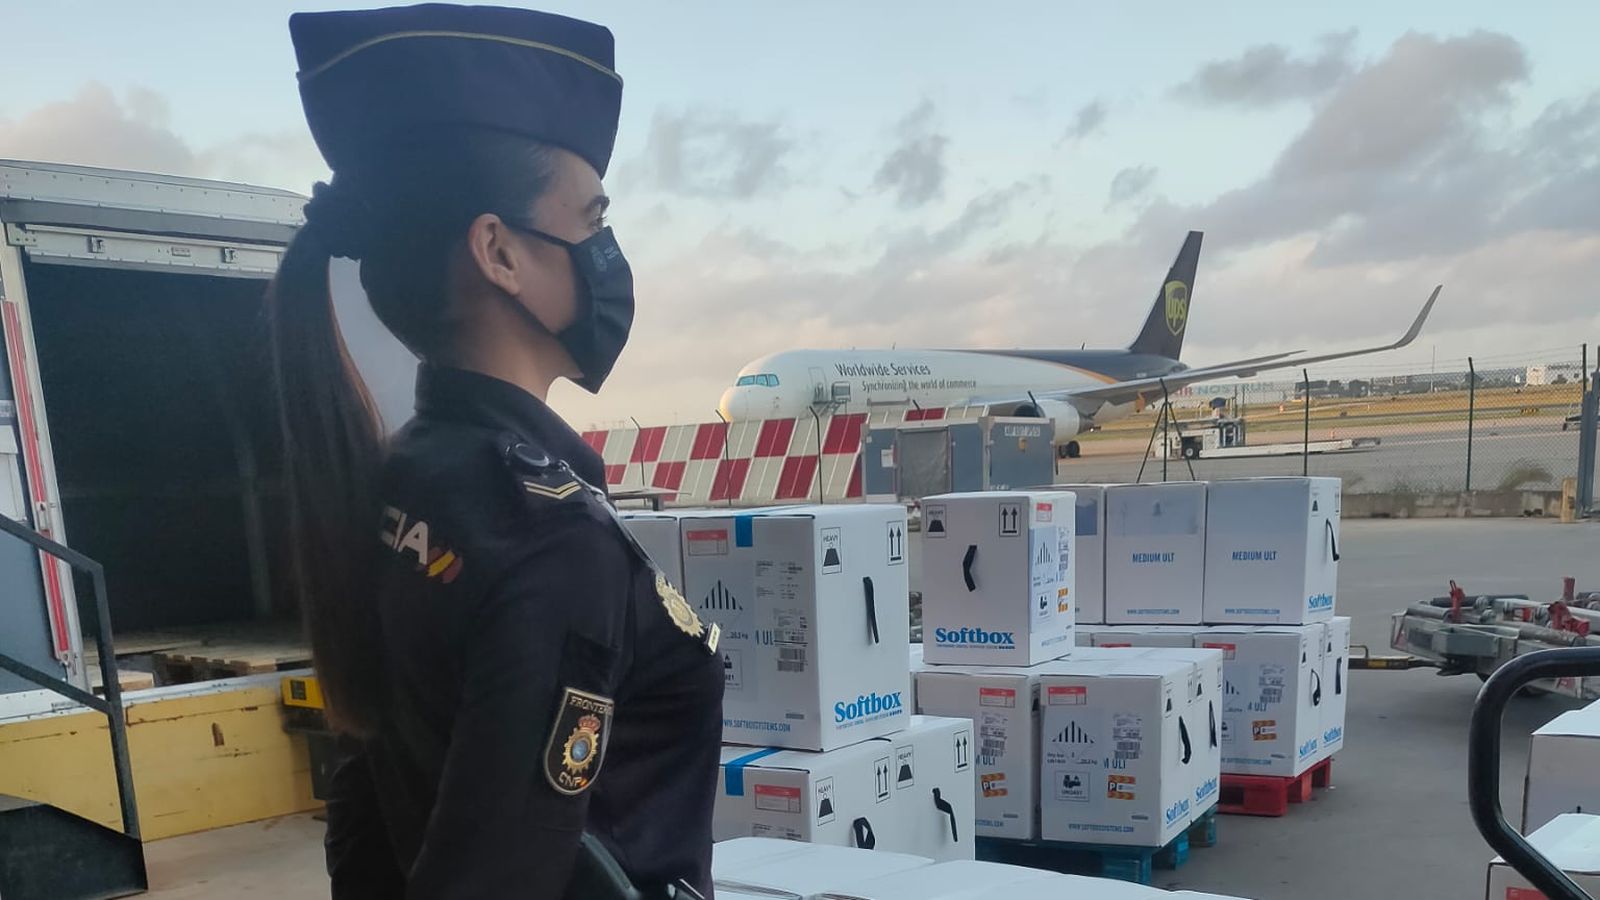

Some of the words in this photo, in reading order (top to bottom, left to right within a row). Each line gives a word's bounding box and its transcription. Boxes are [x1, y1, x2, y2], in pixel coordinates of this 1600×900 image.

[835, 363, 890, 376] Worldwide
[890, 363, 931, 376] Services
[862, 380, 907, 392] Synchronizing
[908, 380, 919, 390] the
[920, 379, 937, 390] world
[939, 379, 946, 389] of
[947, 380, 976, 389] commerce
[1132, 552, 1160, 563] MEDIUM
[1162, 552, 1175, 562] ULT
[1232, 551, 1261, 561] MEDIUM
[1263, 550, 1277, 561] ULT
[935, 627, 1014, 644] Softbox
[835, 691, 902, 722] Softbox
[558, 771, 582, 787] CNP
